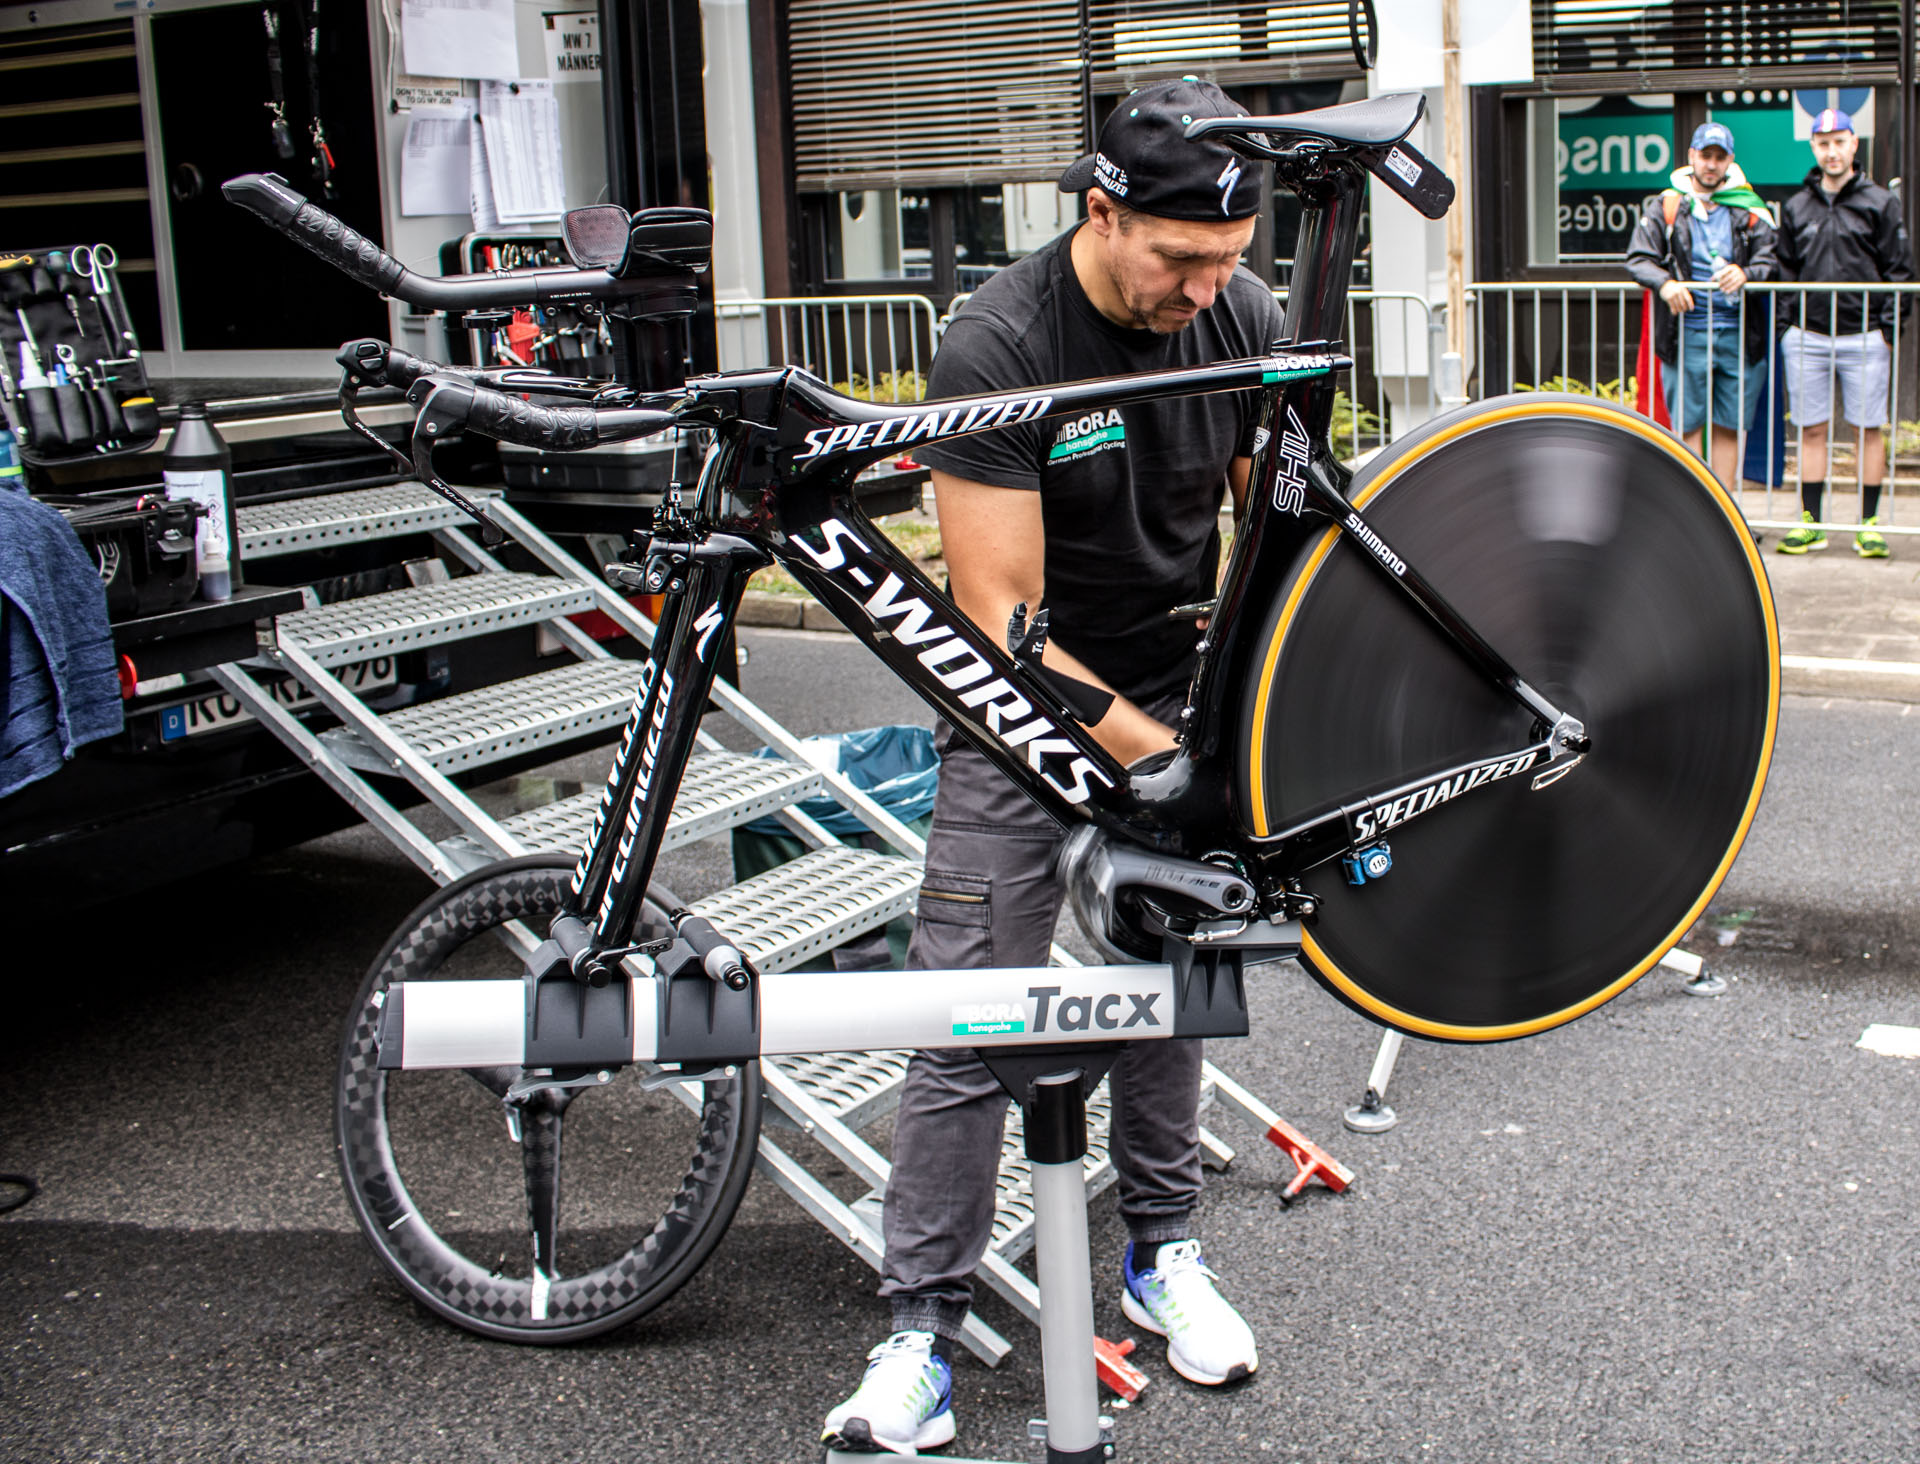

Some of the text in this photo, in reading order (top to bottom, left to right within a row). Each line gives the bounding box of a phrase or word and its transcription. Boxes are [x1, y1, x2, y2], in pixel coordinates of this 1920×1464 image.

[563, 32, 592, 48] MW 7
[557, 53, 600, 71] MÄNNER
[406, 95, 416, 104] TO
[417, 88, 432, 97] TELL
[433, 89, 443, 97] ME
[445, 89, 459, 97] HOW
[1096, 152, 1120, 179] CRAFT
[1276, 354, 1330, 371] BORA
[793, 396, 1052, 459] SPECIALIZED
[1064, 408, 1124, 441] BORA
[1102, 440, 1126, 450] Cycling
[1273, 404, 1310, 518] SHIV
[1345, 512, 1407, 577] SHIMANO
[789, 518, 1115, 805] S-WORKS
[1353, 751, 1538, 844] SPECIALIZED
[1372, 856, 1387, 870] 116
[967, 1003, 1026, 1022] BORA
[1027, 986, 1162, 1033] Tacx
[967, 1022, 1012, 1034] hansgrohe
